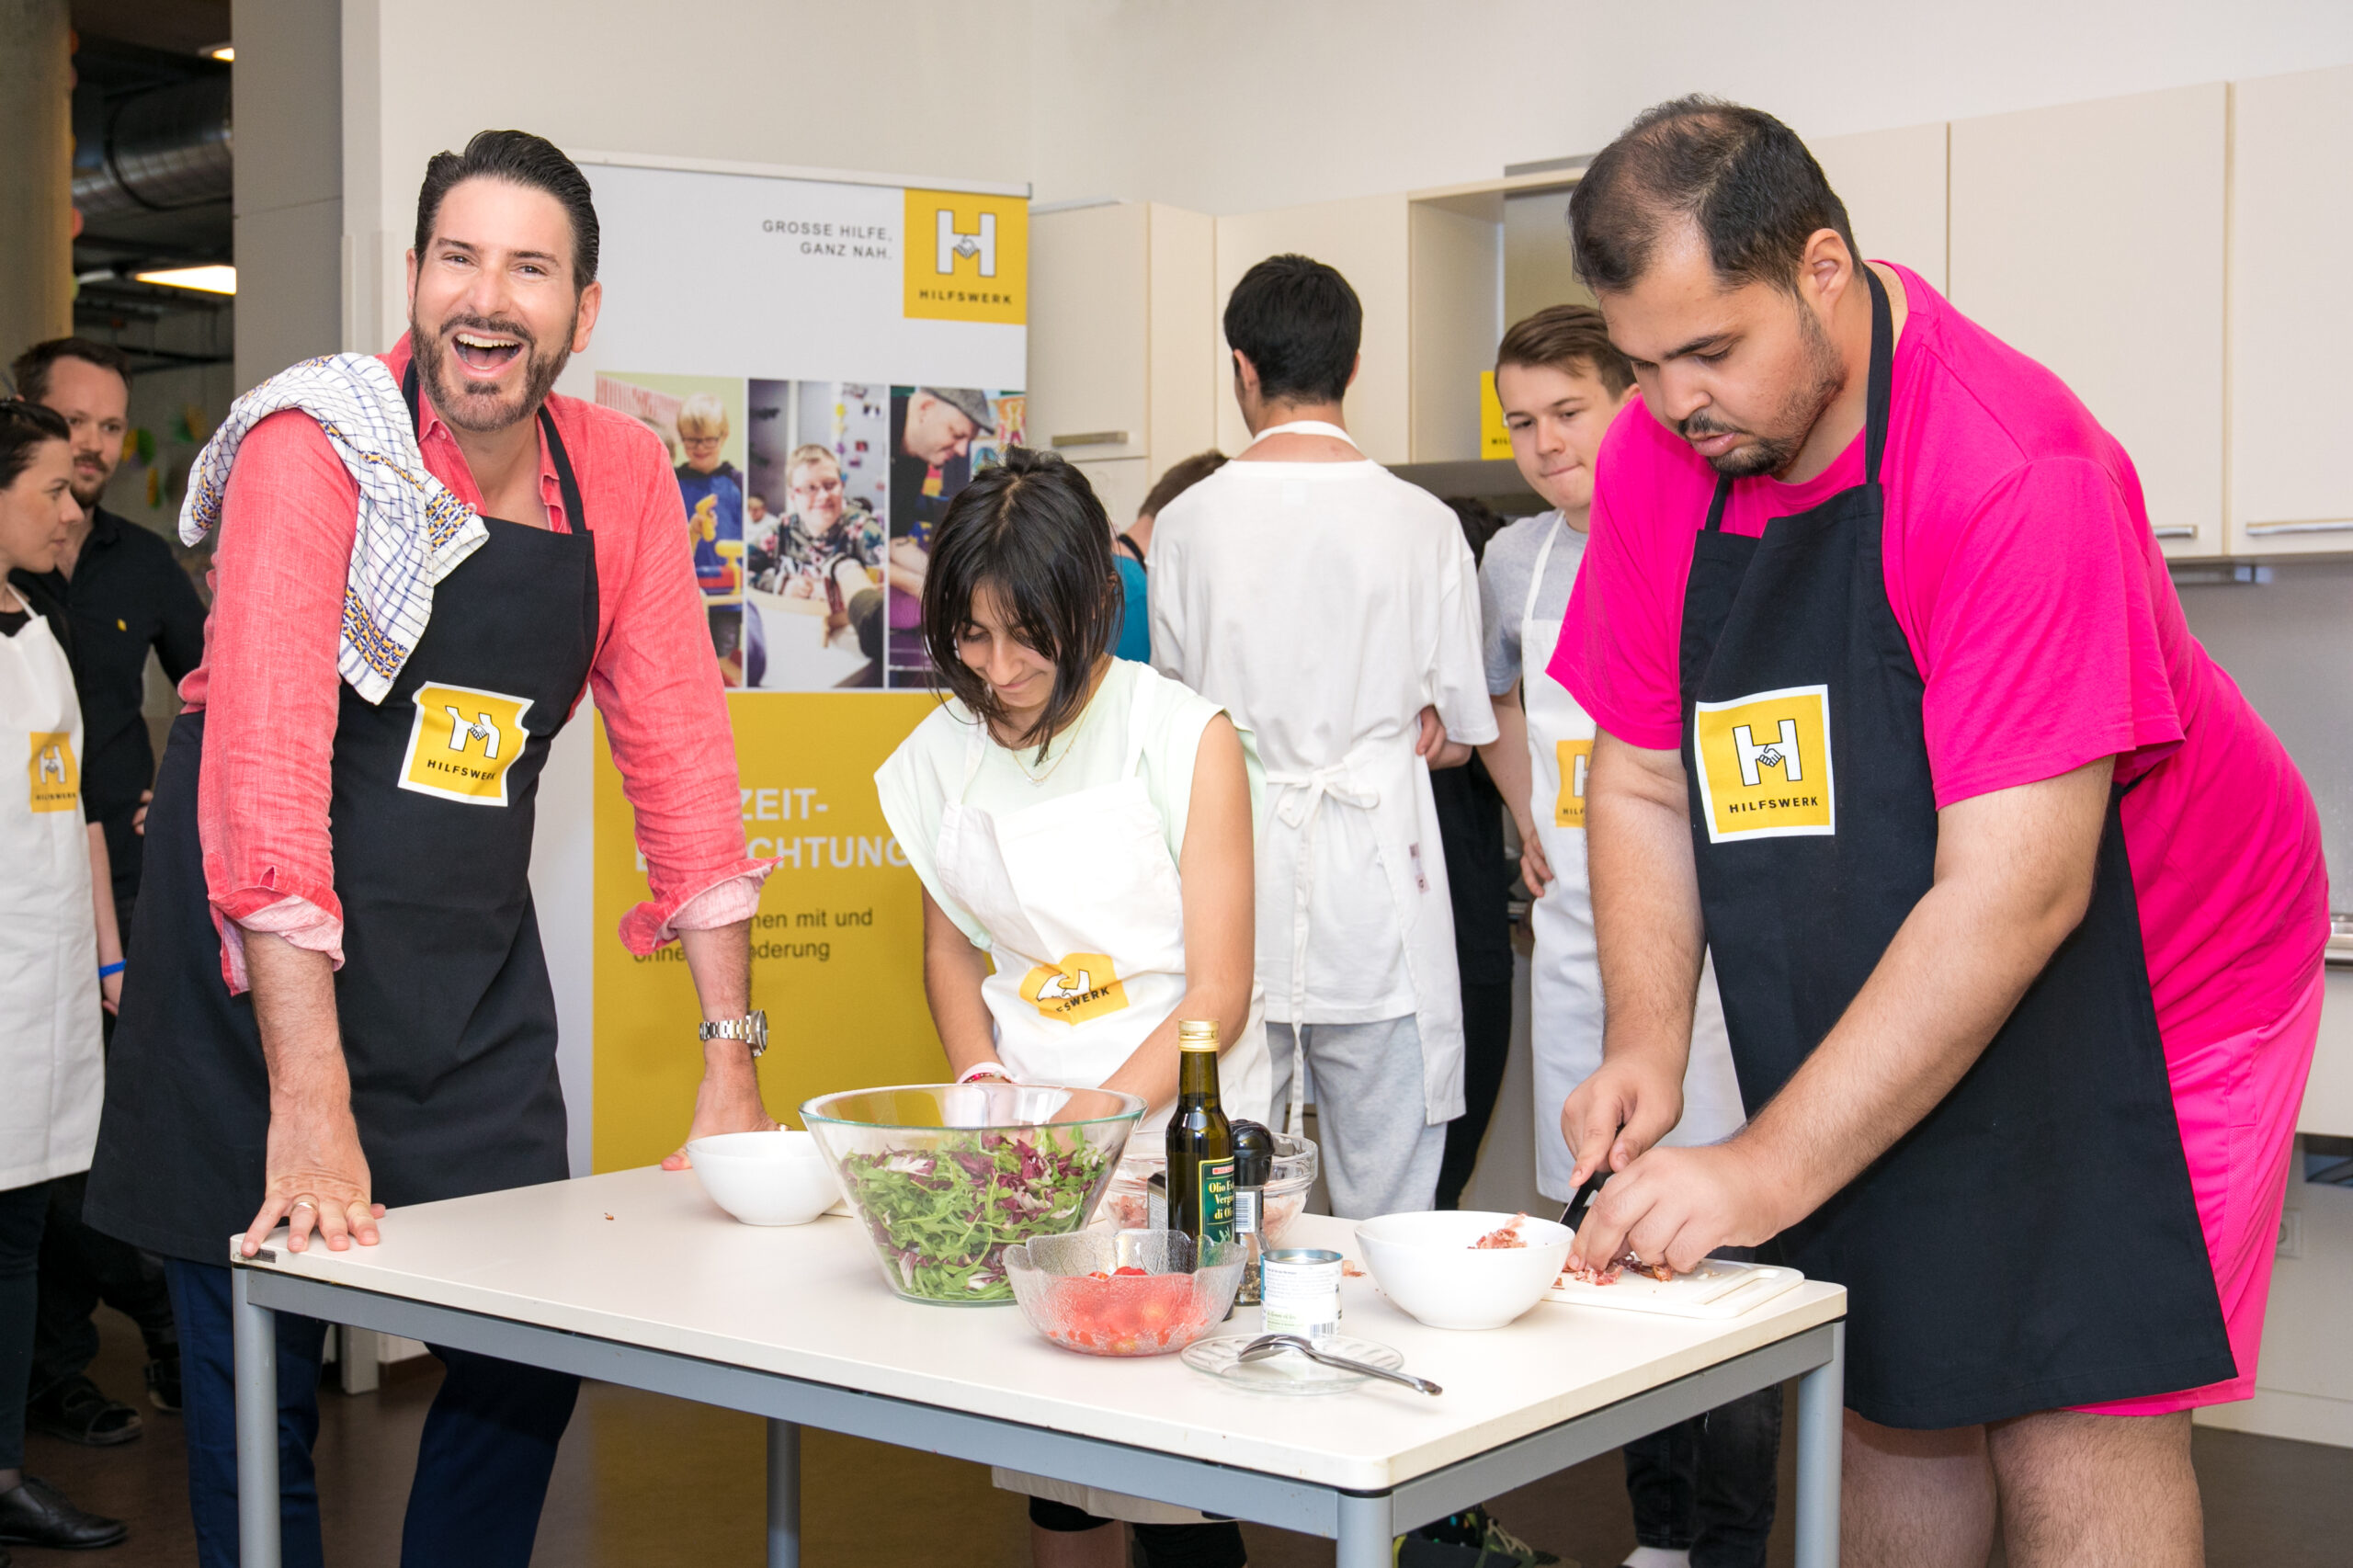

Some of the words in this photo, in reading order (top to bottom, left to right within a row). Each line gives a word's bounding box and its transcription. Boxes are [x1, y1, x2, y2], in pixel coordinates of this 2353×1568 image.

[762, 220, 833, 237] GROSSE
[839, 225, 893, 242] HILFE,
[800, 241, 847, 258] GANZ
[852, 244, 892, 260] NAH.
[919, 290, 1012, 305] HILFSWERK
[1729, 796, 1818, 813] HILFSWERK
[796, 907, 827, 927] mit
[835, 906, 873, 927] und
[751, 939, 831, 962] derung
[1209, 1182, 1226, 1193] Olio
[1214, 1208, 1223, 1220] di
